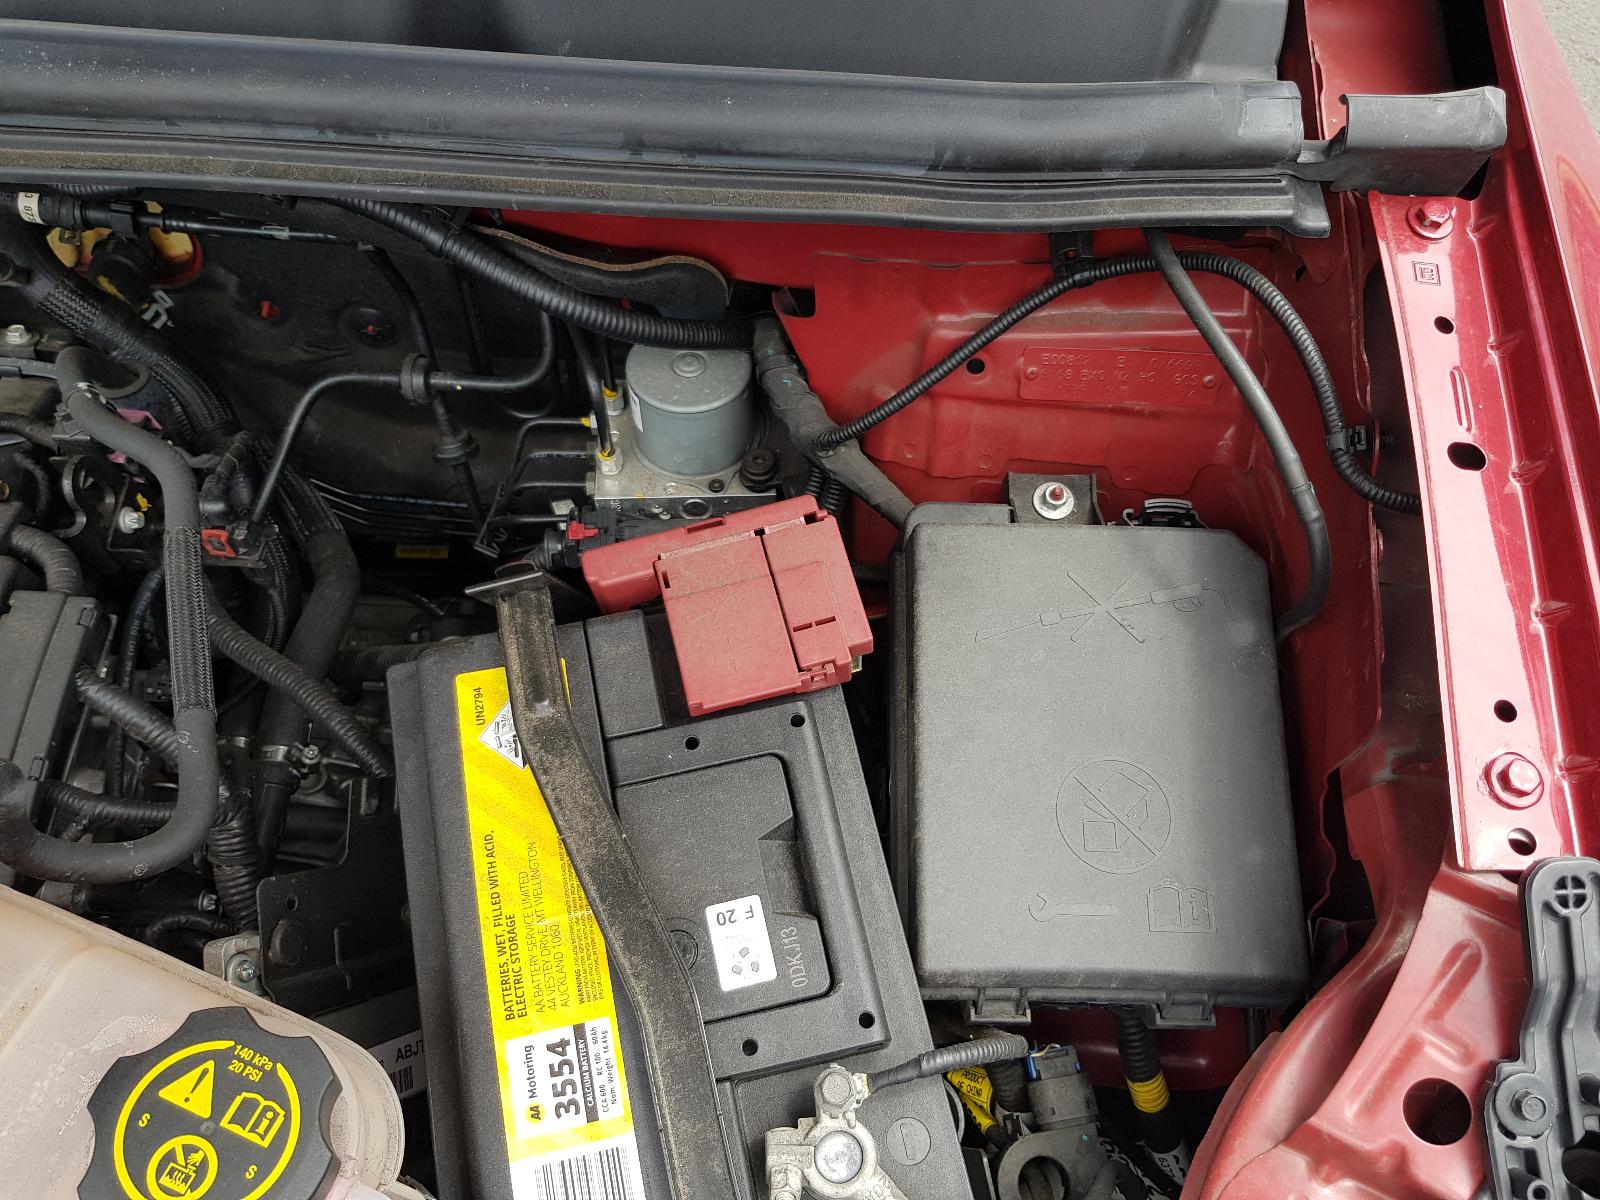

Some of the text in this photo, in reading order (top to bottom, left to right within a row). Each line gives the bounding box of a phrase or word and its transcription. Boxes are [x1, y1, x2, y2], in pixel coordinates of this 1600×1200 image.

[474, 686, 486, 726] UN2794
[487, 861, 499, 889] WITH
[527, 841, 543, 905] WELLINGTON
[490, 892, 503, 927] FILLED
[535, 909, 545, 923] MT
[716, 905, 754, 926] F 20
[495, 930, 507, 957] WET,
[518, 871, 545, 1013] AA BATTERY SERVICE LIMITED
[538, 925, 551, 956] DRIVE,
[505, 914, 527, 1017] ELECTRIC STORAGE
[542, 960, 555, 995] VESTEY
[549, 924, 570, 1007] AUCKLAND 1060
[499, 959, 515, 1020] BATTERIES,
[574, 969, 585, 1004] WARNING
[590, 1027, 598, 1044] 60Ah
[228, 1060, 263, 1082] 20 PSI
[234, 1044, 274, 1070] 140 kPa
[578, 1039, 594, 1106] CALCIUM BATTERY
[596, 1067, 603, 1075] RC
[605, 1058, 614, 1083] Weight
[523, 1045, 541, 1120] AA Motoring
[546, 1038, 580, 1119] 3554
[960, 1070, 986, 1085] PRODUCT
[966, 1084, 982, 1098] CHINA
[601, 1098, 609, 1112] CCA
